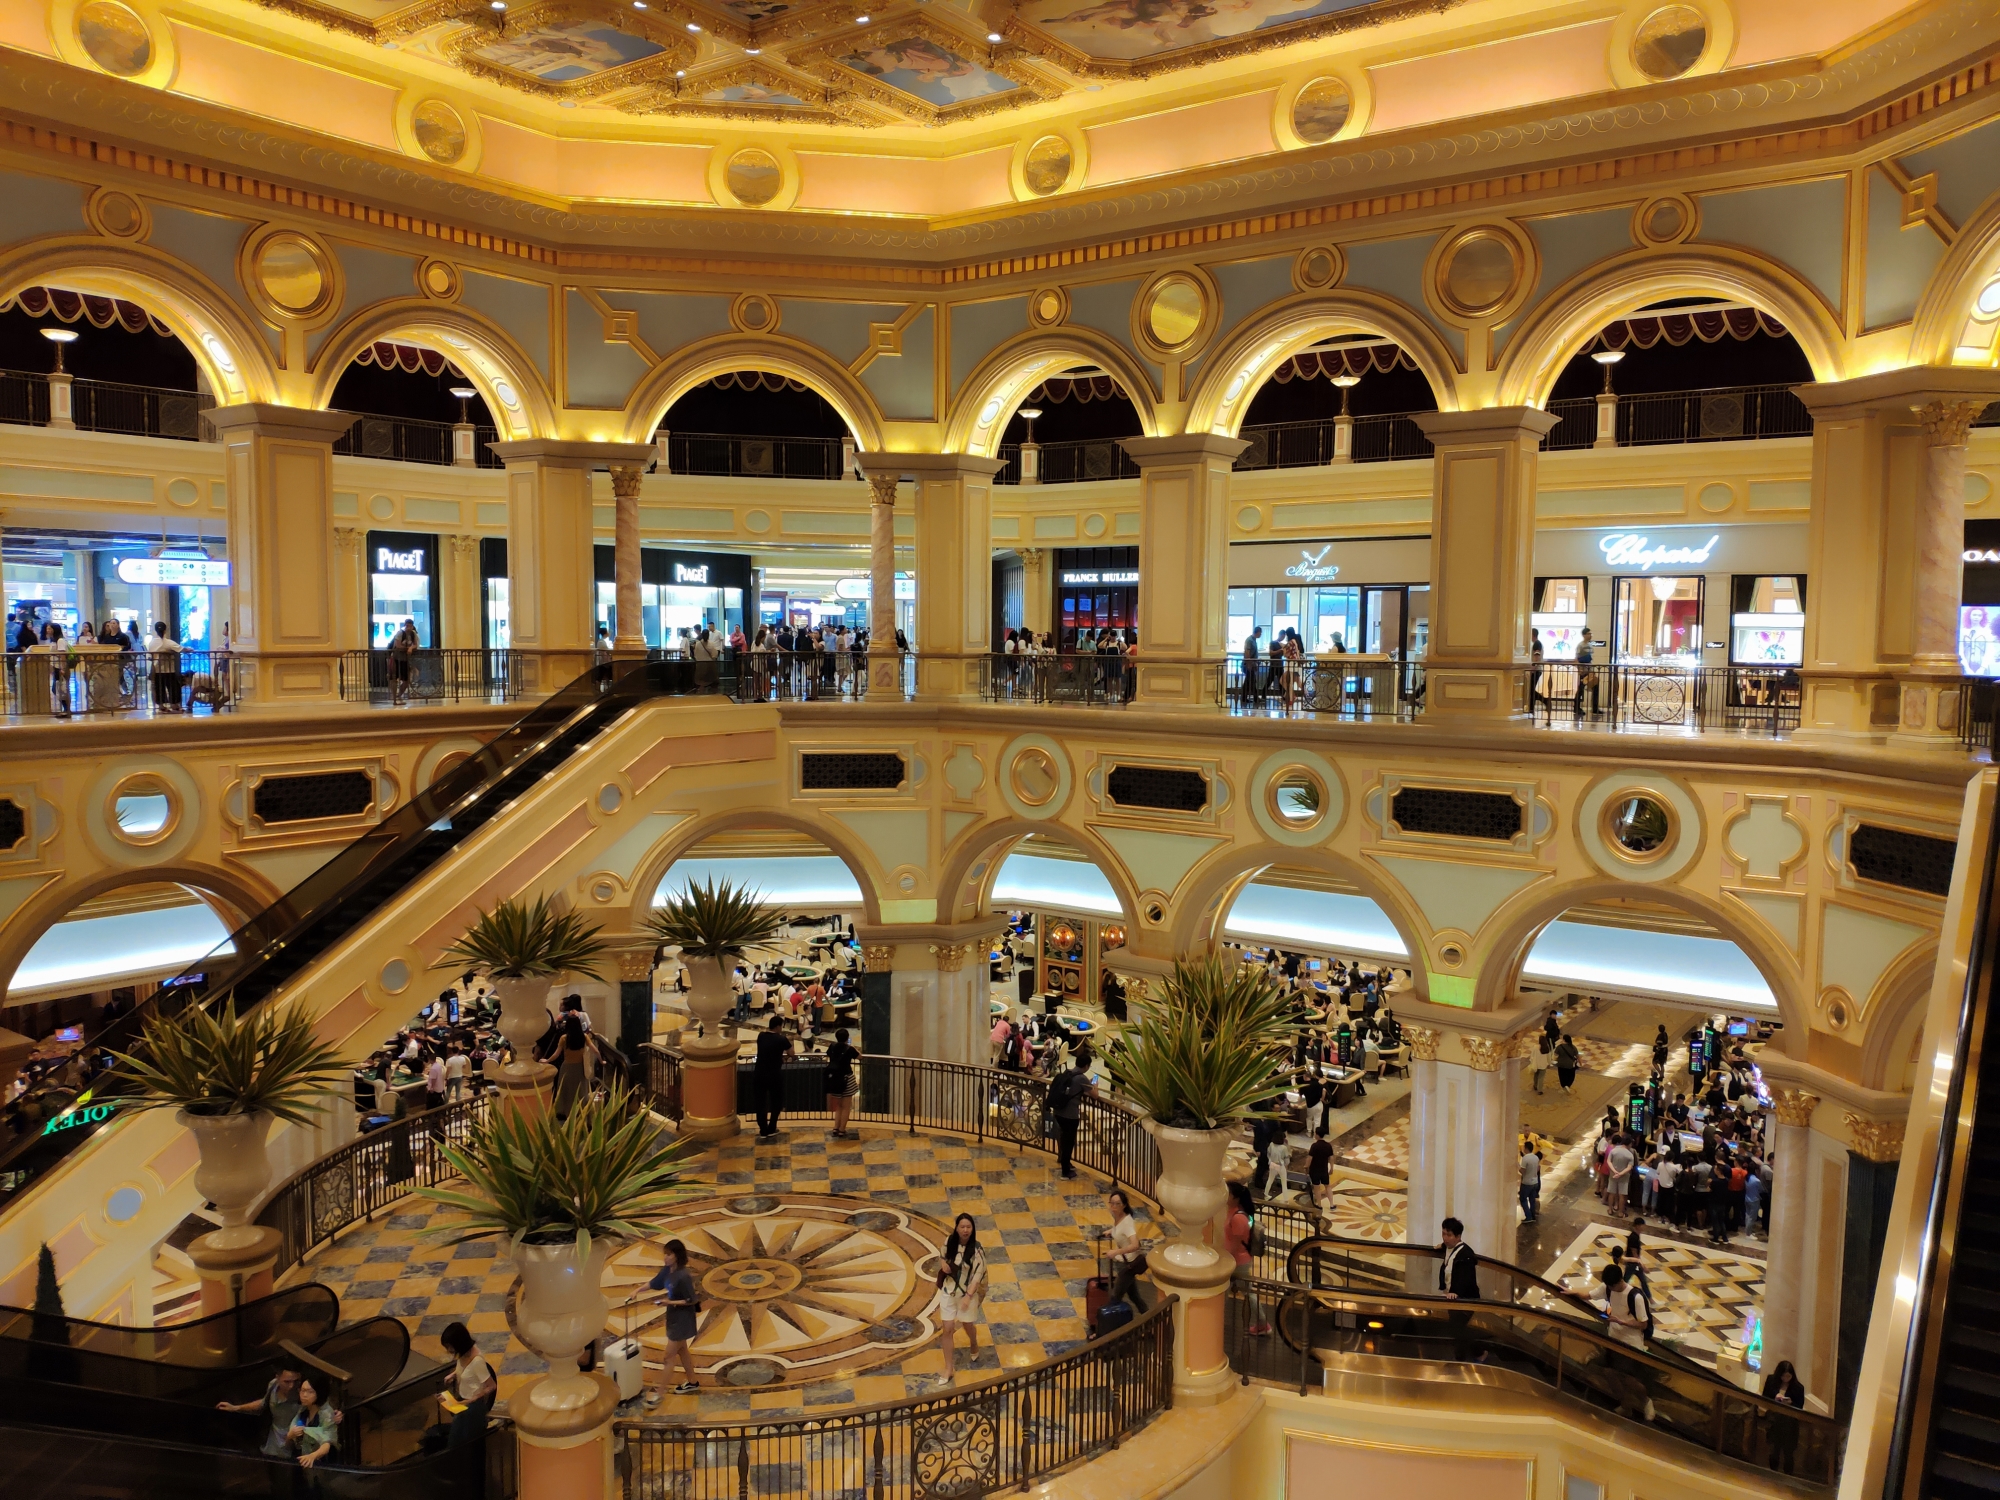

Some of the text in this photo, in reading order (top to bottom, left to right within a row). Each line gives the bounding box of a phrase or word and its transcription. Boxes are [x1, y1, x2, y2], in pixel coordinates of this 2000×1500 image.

[378, 547, 424, 572] PIAGET
[1599, 534, 1719, 571] Chopard
[1962, 550, 2000, 562] OA
[676, 564, 709, 584] PIAGET
[1063, 572, 1139, 583] FRANCK MULLER
